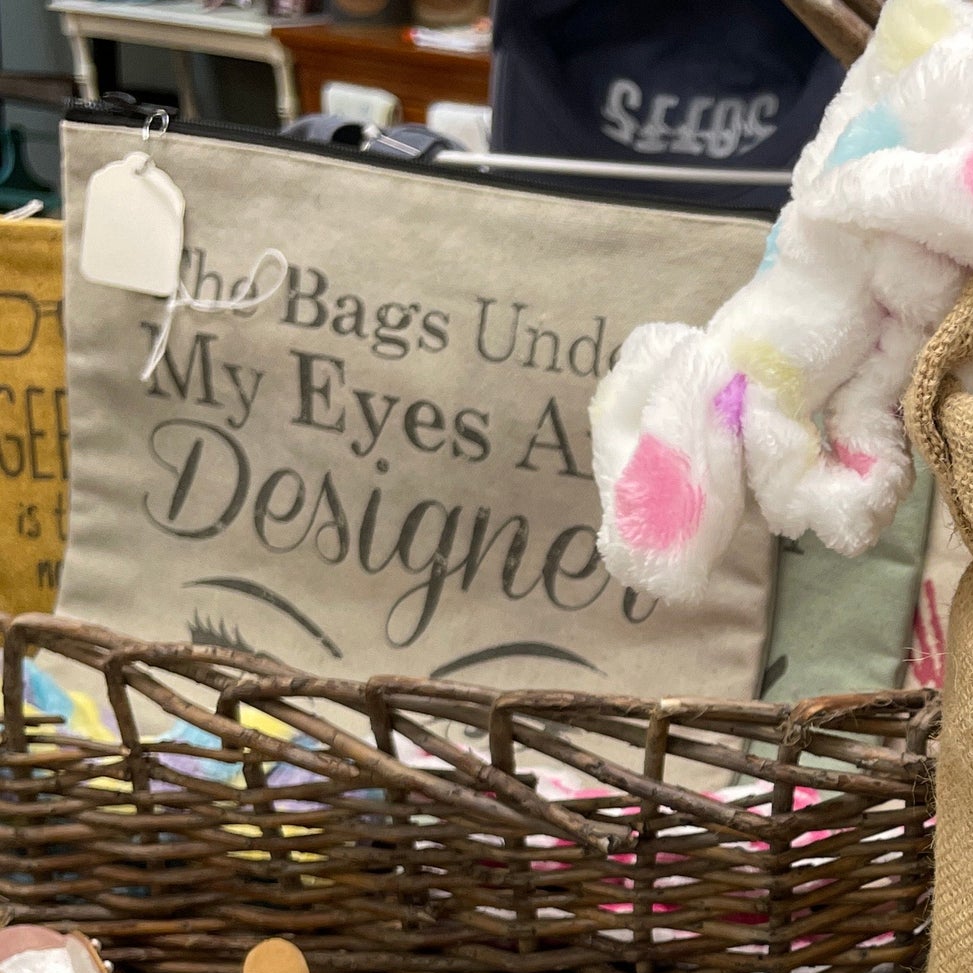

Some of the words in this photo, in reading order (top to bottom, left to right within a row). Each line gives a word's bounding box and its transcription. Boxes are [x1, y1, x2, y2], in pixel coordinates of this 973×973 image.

[181, 247, 258, 318] he
[280, 264, 449, 360] Bags
[140, 321, 264, 430] My
[289, 350, 491, 462] Eyes
[515, 397, 594, 481] A
